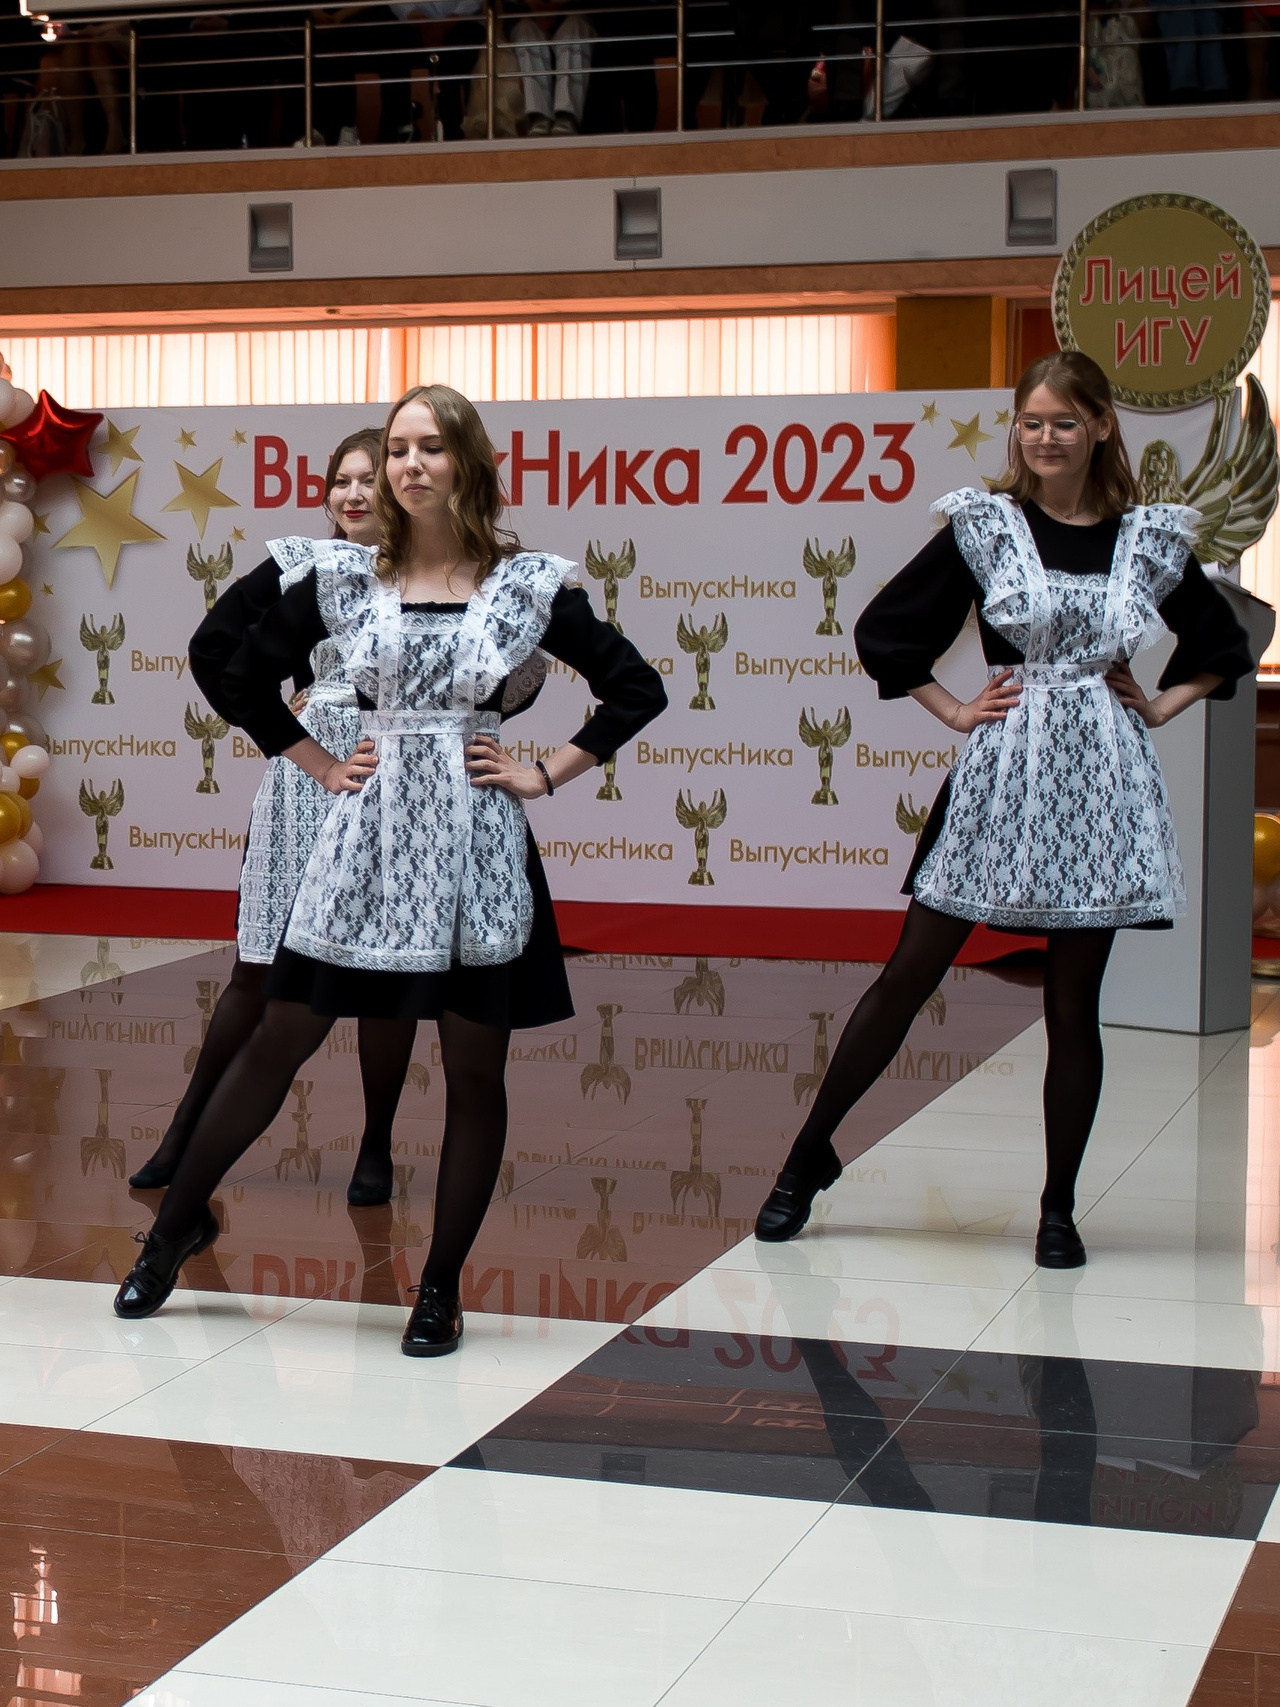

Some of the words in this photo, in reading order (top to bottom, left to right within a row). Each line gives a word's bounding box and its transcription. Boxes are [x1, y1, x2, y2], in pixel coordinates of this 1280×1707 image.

[1079, 252, 1242, 308] Лицей
[1114, 316, 1212, 369] ИГУ
[254, 428, 700, 511] ВыНика
[722, 421, 916, 505] 2023
[639, 574, 797, 607] ВыпускНика
[735, 651, 864, 684] ВыпускНи
[637, 740, 794, 773] ВыпускНика
[856, 743, 958, 776] Выпуск
[129, 826, 247, 856] ВыпускНи
[537, 836, 673, 866] ыпускНика
[729, 838, 889, 871] ВыпускНика
